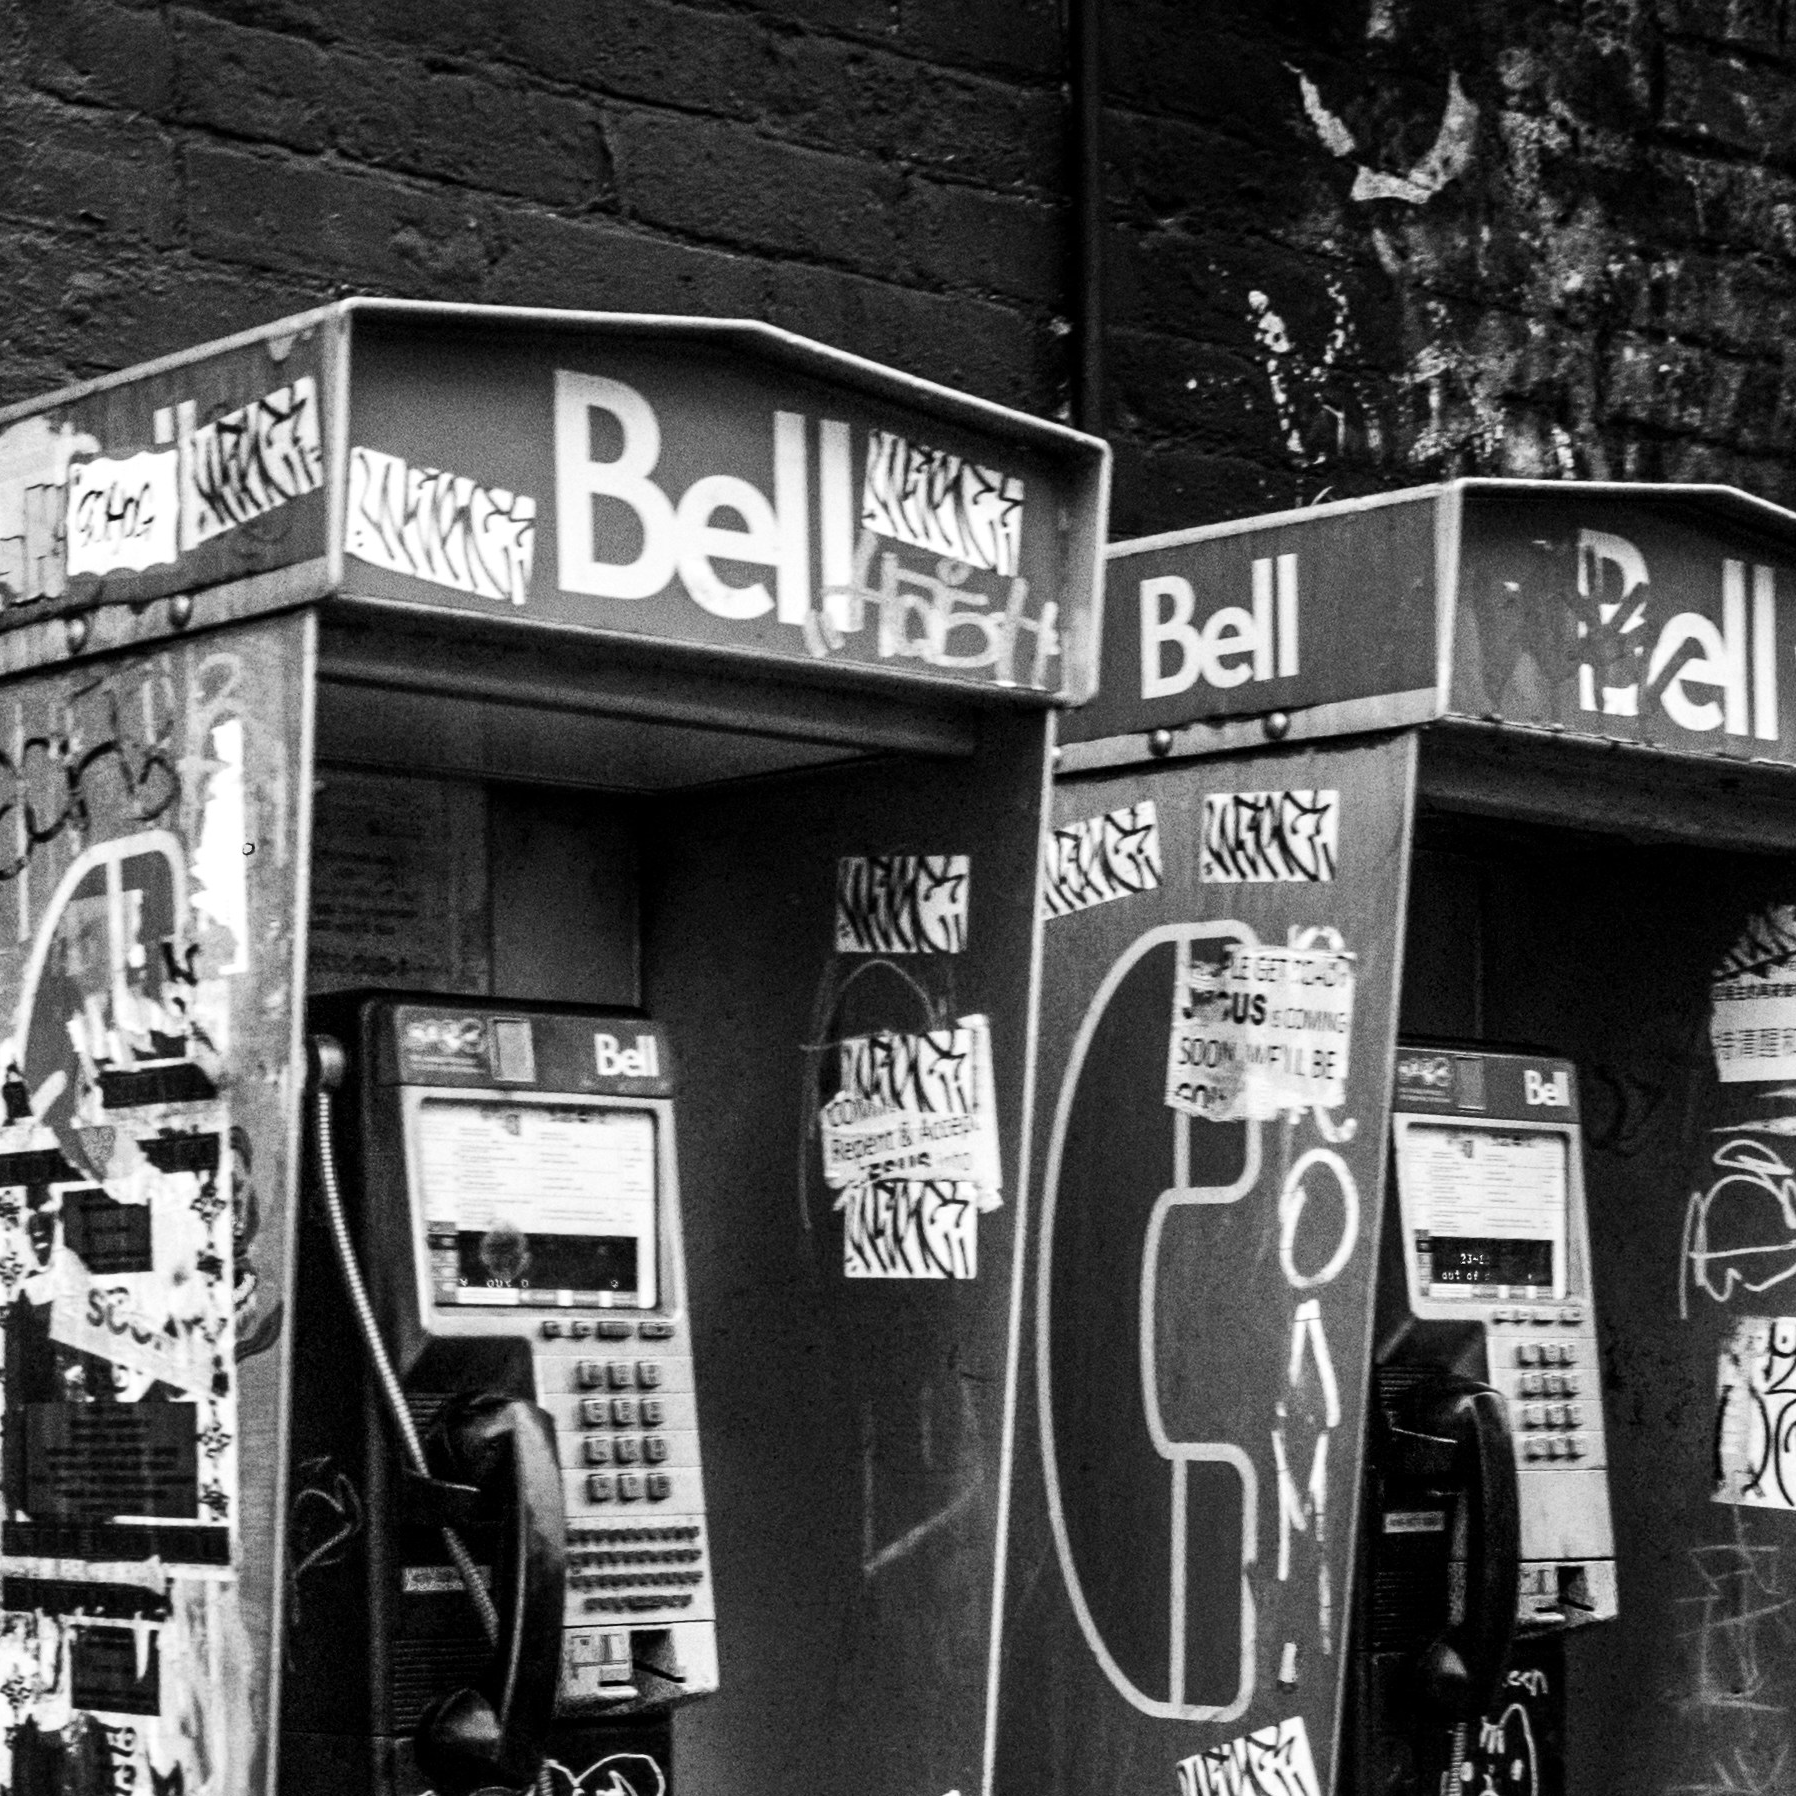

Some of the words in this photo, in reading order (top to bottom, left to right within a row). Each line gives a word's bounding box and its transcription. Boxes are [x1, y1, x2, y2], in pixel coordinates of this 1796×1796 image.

[553, 369, 861, 633] Bell
[1140, 553, 1299, 700] Bell
[593, 1033, 660, 1078] Bell
[1311, 1050, 1337, 1081] BE
[1523, 1069, 1571, 1107] Bell
